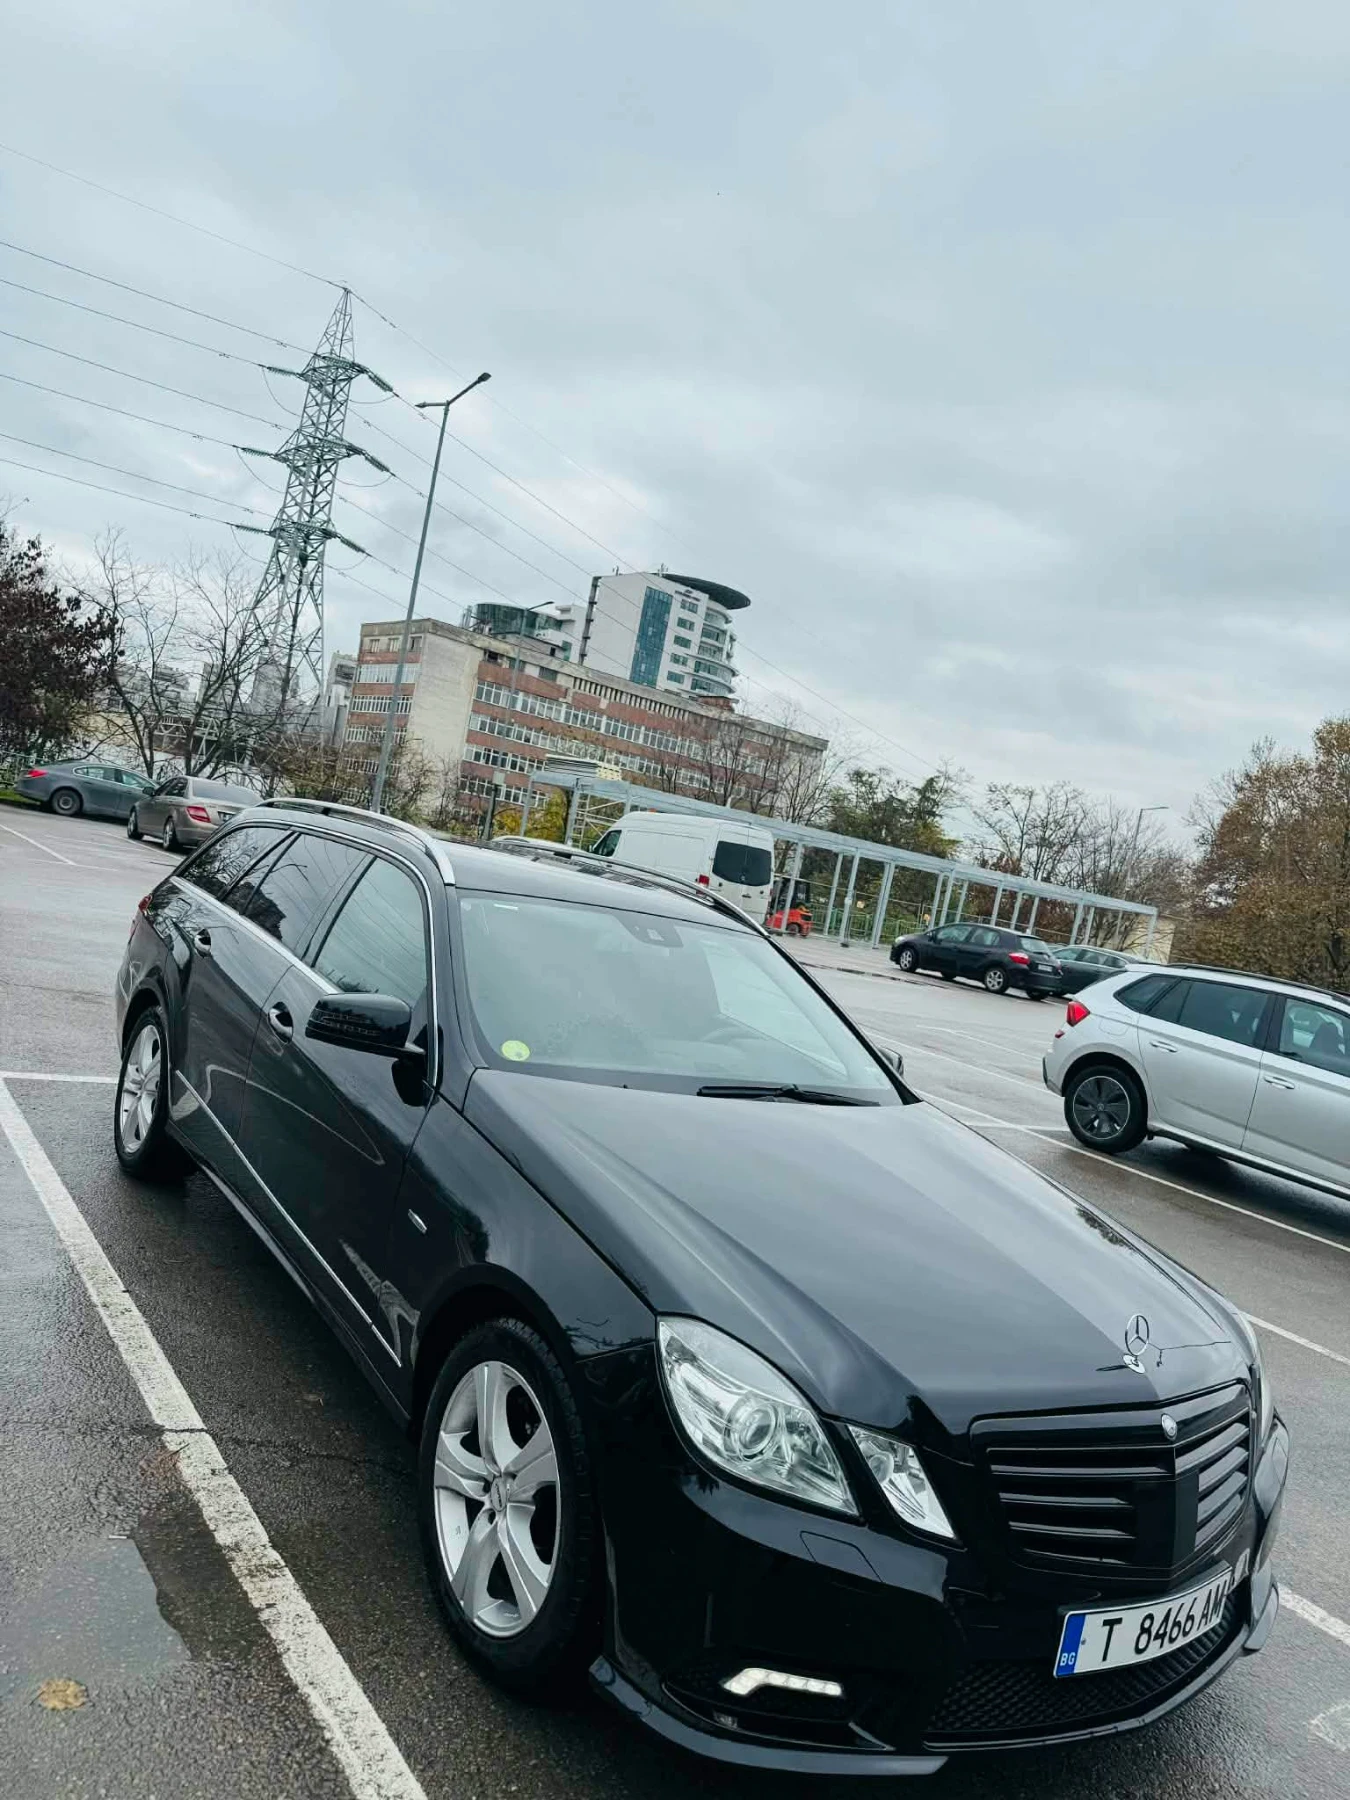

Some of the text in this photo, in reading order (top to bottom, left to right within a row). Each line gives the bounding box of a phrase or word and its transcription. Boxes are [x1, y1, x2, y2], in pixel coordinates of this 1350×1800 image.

[1102, 1579, 1228, 1662] T 8466 AM
[1060, 1652, 1076, 1666] BG
